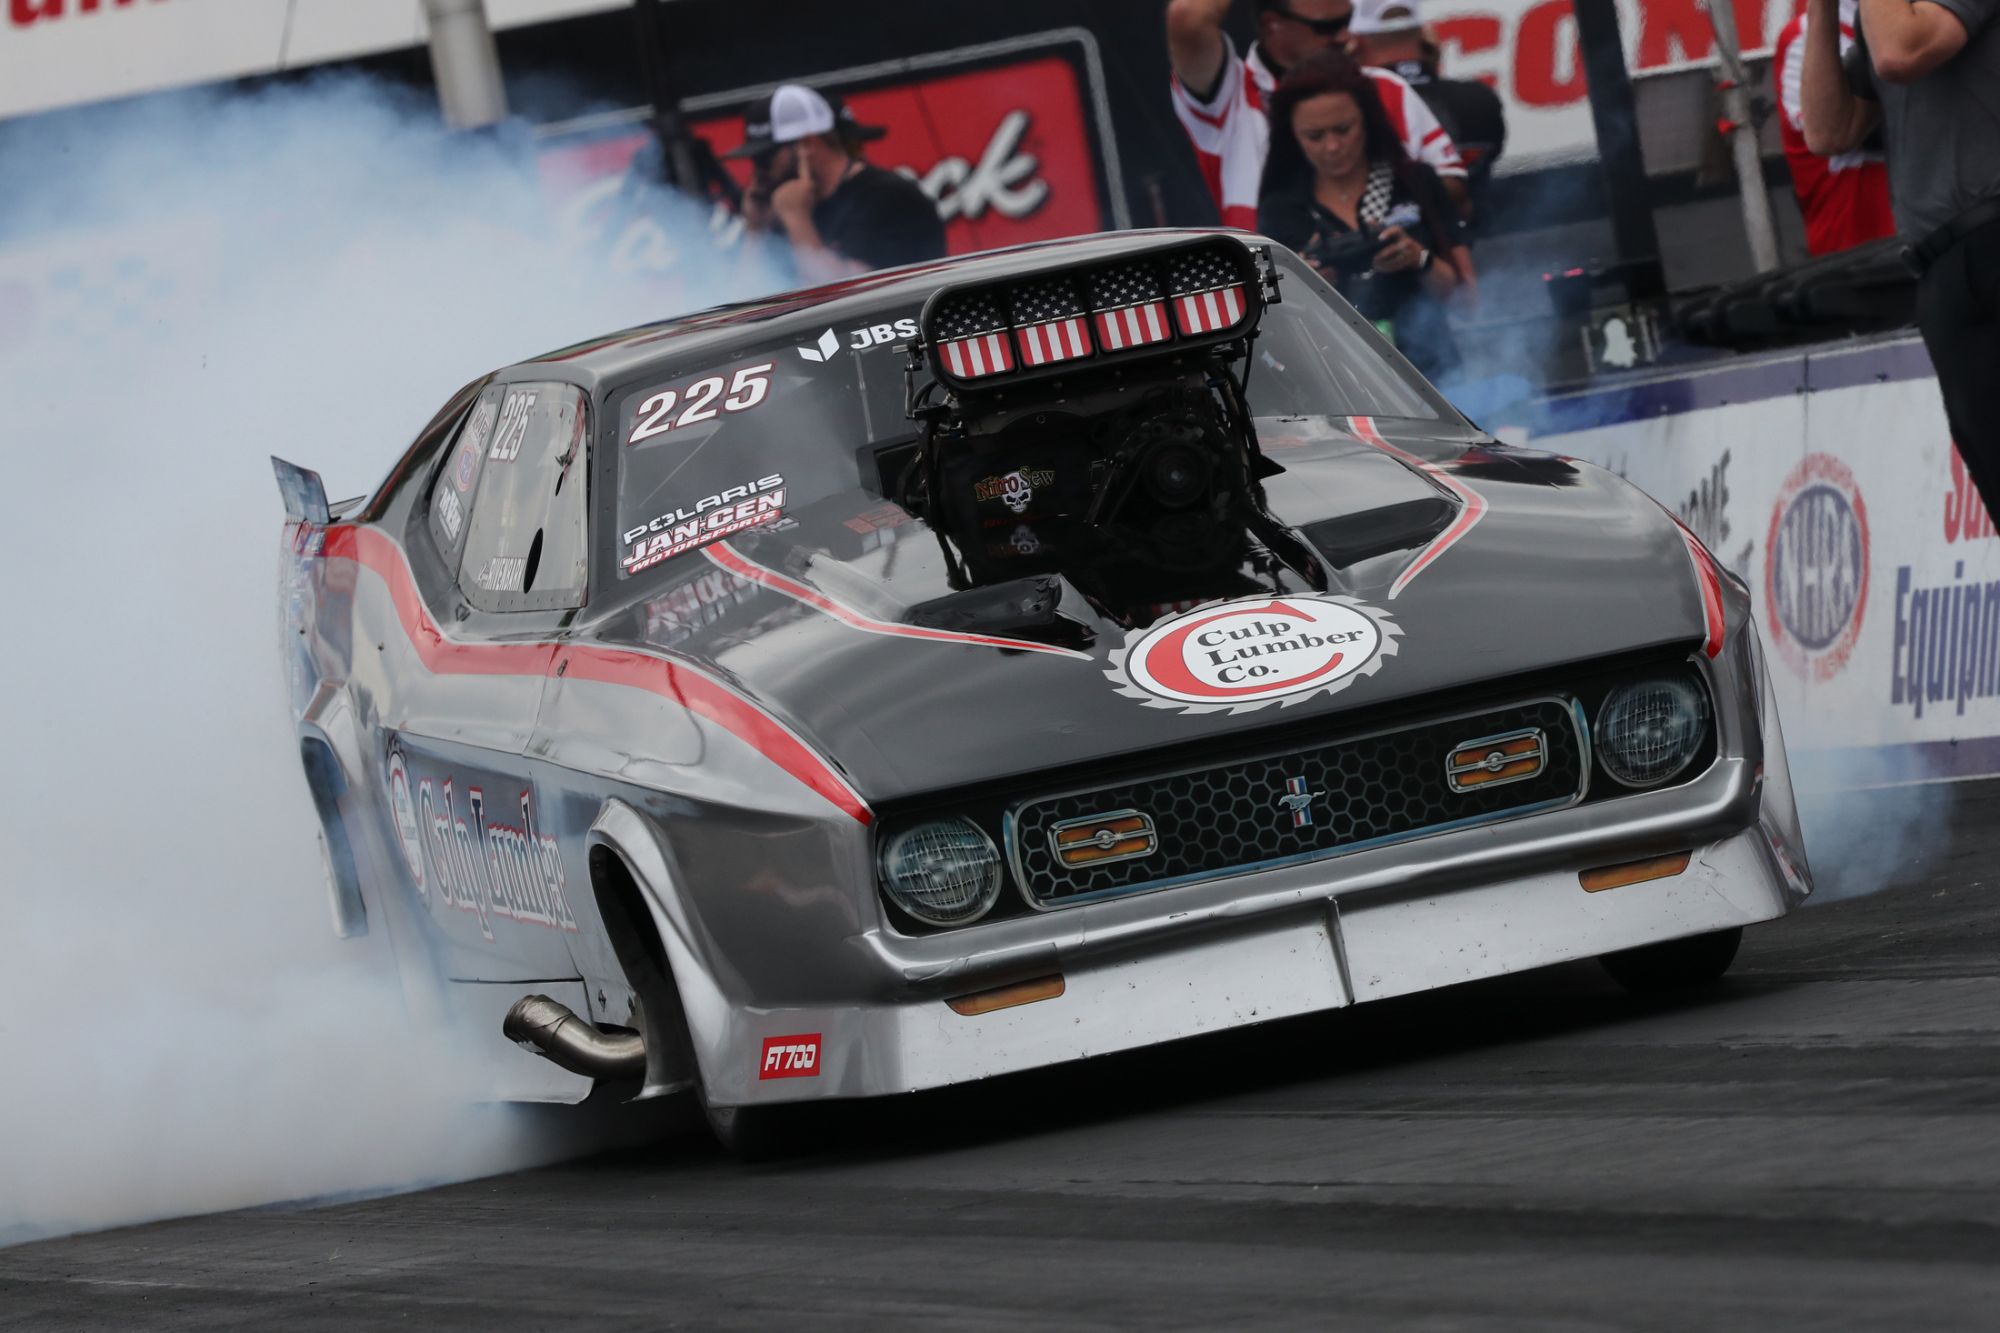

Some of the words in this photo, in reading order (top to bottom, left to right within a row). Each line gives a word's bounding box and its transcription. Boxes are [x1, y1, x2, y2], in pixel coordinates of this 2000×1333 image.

[850, 318, 919, 350] JBS
[489, 390, 538, 462] 225
[628, 361, 776, 445] 225
[623, 473, 784, 545] POLARIS
[975, 475, 1020, 501] Nitro
[1019, 466, 1055, 489] Sew
[630, 509, 779, 573] MOTORSPORTS
[1778, 494, 1858, 641] NHRA
[1196, 620, 1291, 647] Culp
[1204, 629, 1365, 667] Lumber
[1217, 664, 1280, 684] Co.
[418, 774, 496, 943] Culp
[468, 786, 578, 933] Lumber
